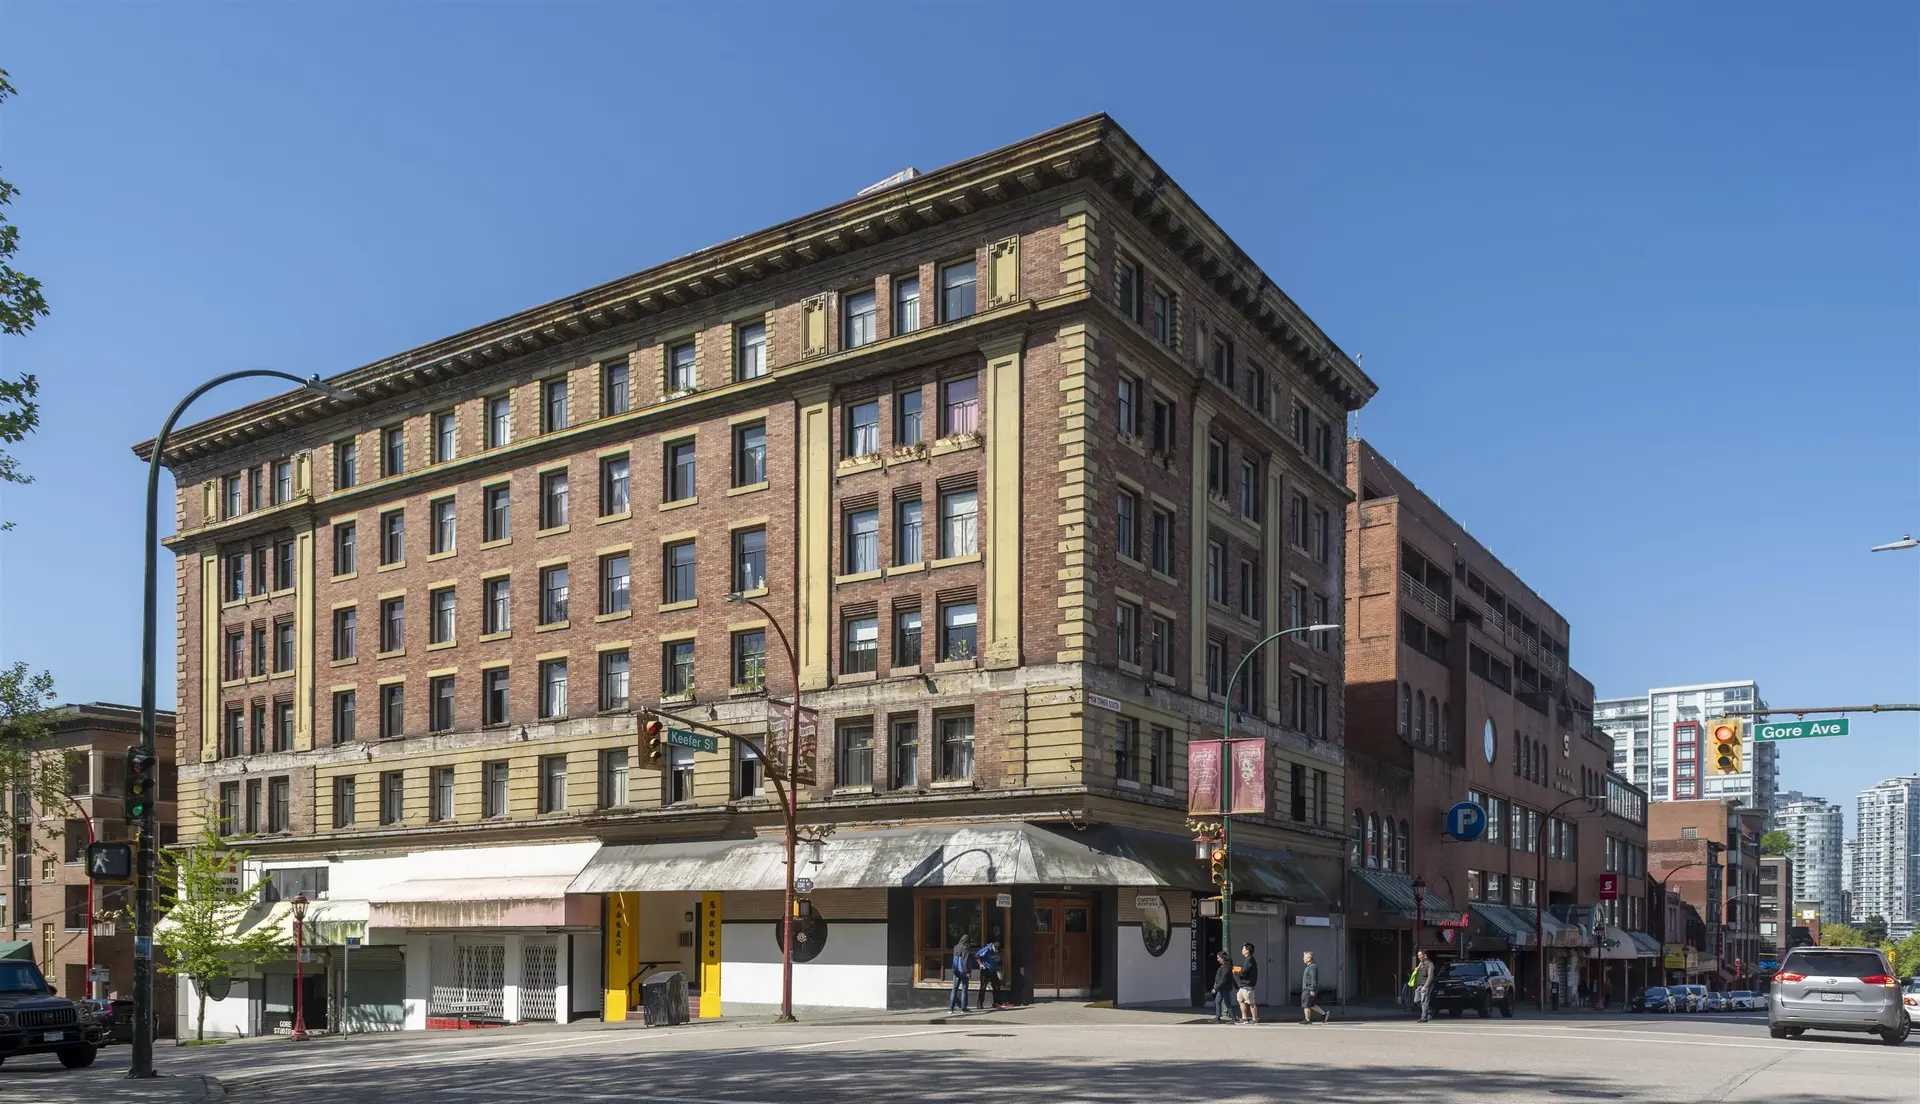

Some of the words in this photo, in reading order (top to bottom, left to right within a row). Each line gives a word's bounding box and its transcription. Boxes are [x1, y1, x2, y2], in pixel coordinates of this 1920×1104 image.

[1762, 726, 1802, 739] Gore
[1809, 723, 1841, 735] Ave
[671, 731, 701, 748] Keefer
[704, 738, 714, 750] St
[1457, 808, 1478, 834] P
[279, 1020, 292, 1028] GORE
